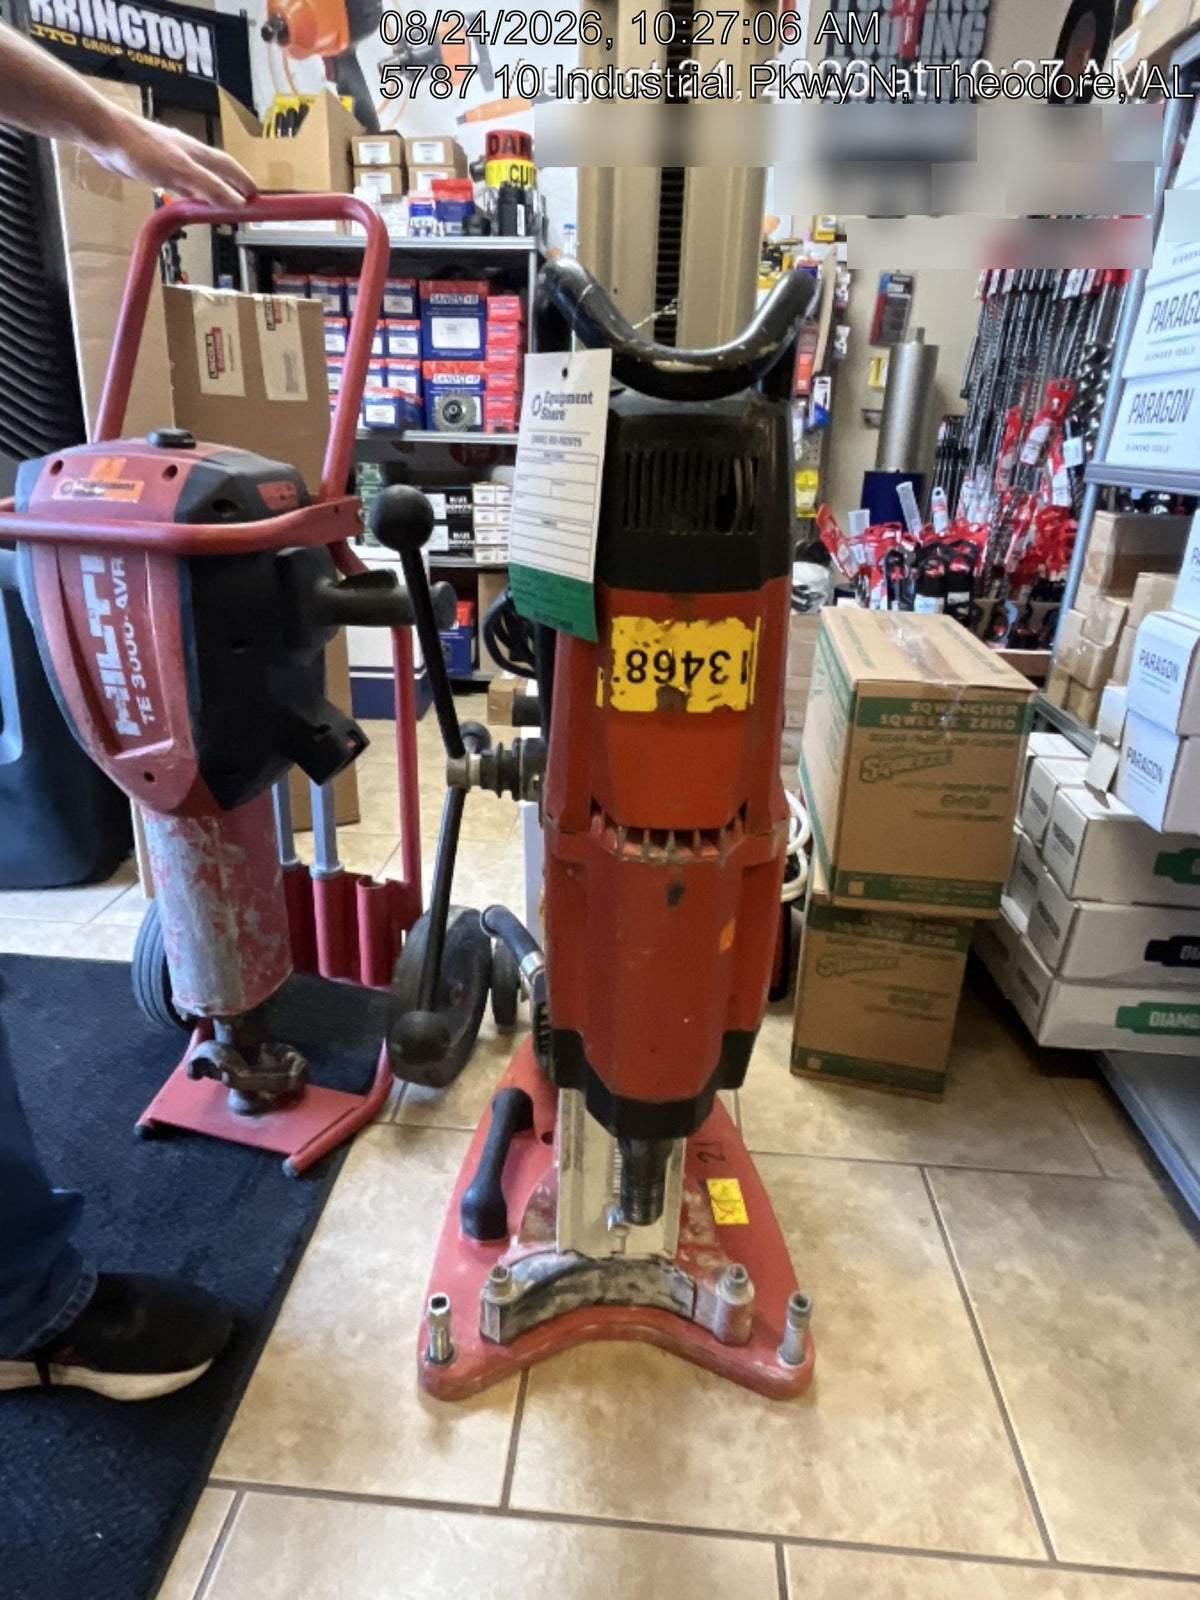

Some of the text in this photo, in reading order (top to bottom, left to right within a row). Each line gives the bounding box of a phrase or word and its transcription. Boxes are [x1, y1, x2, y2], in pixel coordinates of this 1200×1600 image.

[127, 50, 185, 74] COMPANY
[1146, 290, 1200, 334] PARAG
[540, 407, 567, 420] Share
[543, 391, 593, 407] Equipment
[1127, 387, 1195, 424] PARAGON
[80, 555, 142, 737] HILTI
[1138, 648, 1181, 684] PARAGON
[136, 696, 157, 725] TE
[969, 717, 1016, 731] ZERO
[1125, 746, 1165, 785] PARAGON
